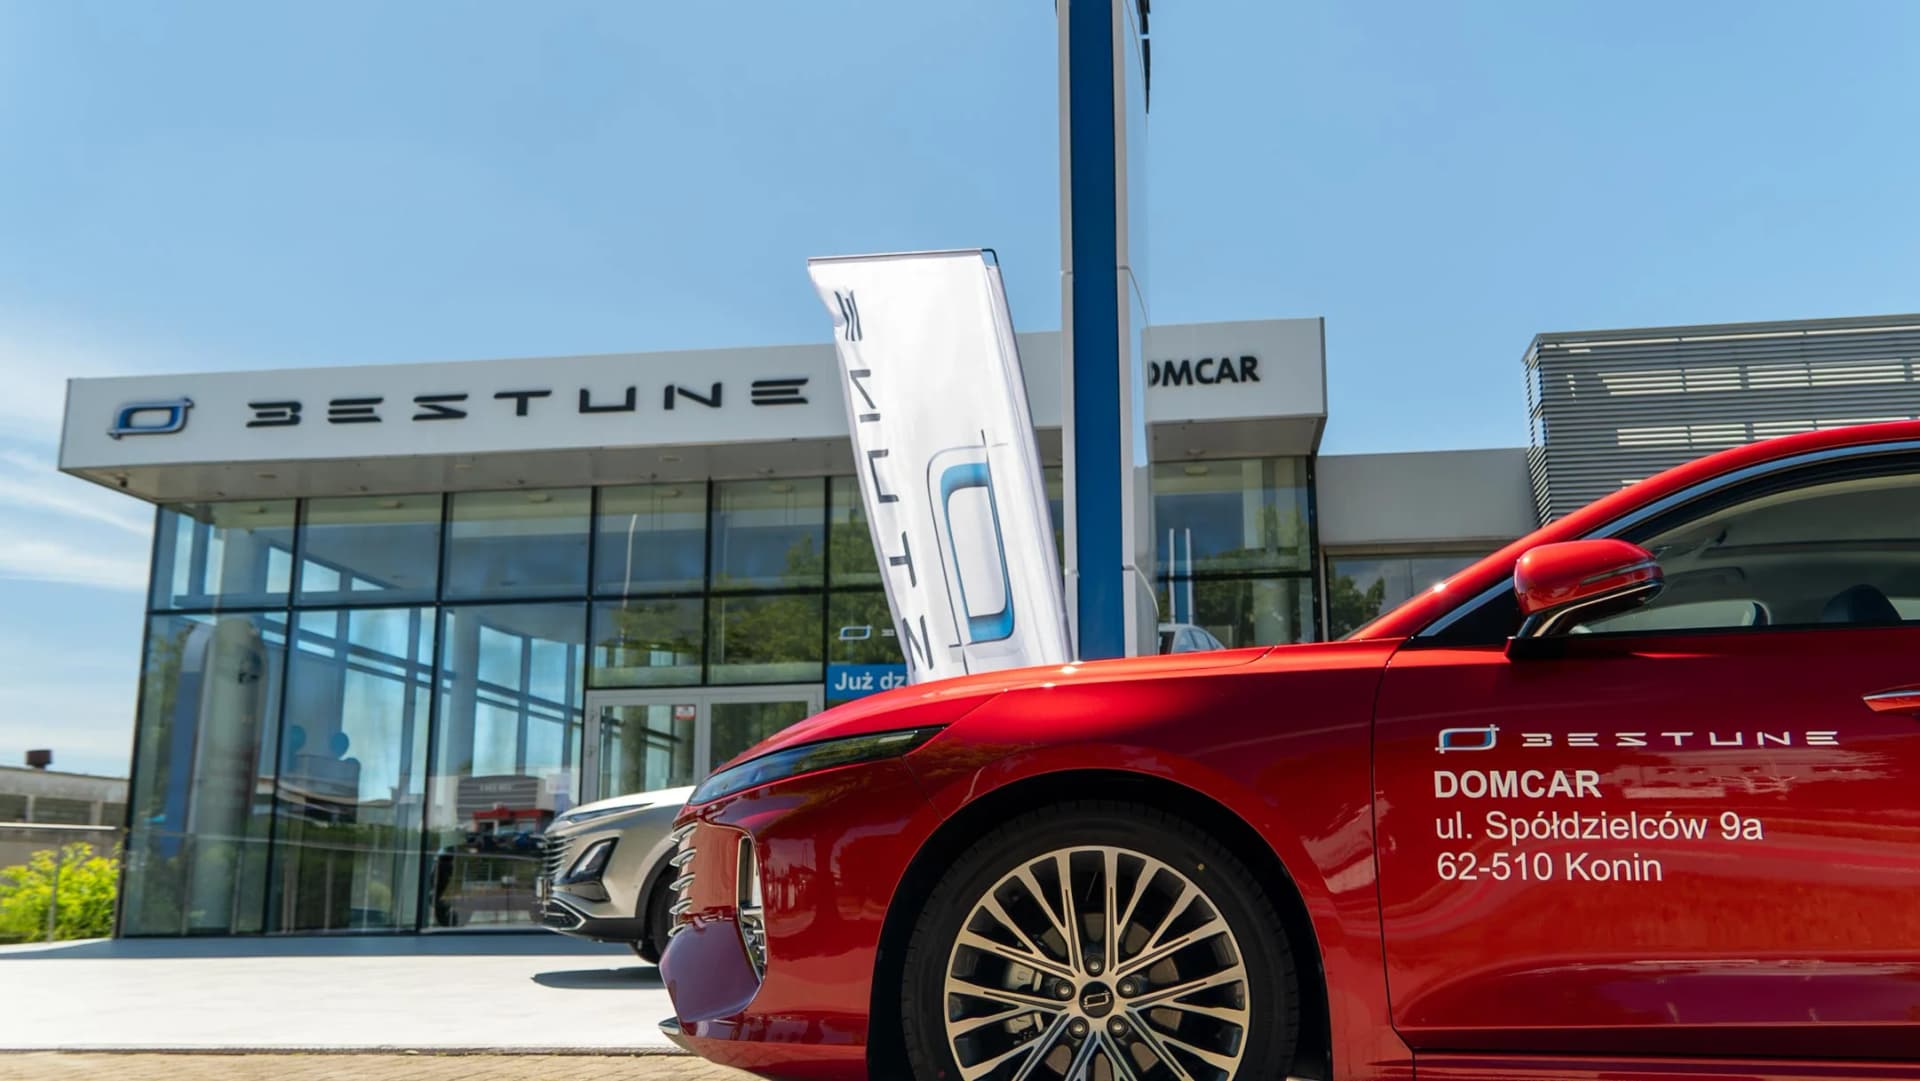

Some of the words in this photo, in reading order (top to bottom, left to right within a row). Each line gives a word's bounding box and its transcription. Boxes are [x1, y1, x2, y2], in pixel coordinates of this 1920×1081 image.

[246, 377, 810, 428] BESTUNE
[834, 671, 873, 691] Już
[880, 671, 907, 690] dz
[1521, 730, 1839, 748] BESTUNE
[1434, 769, 1602, 799] DOMCAR
[1436, 810, 1472, 840] ul.
[1485, 810, 1708, 846] Spółdzielców
[1719, 811, 1764, 841] 9a
[1437, 852, 1553, 881] 62-510
[1565, 852, 1663, 882] Konin
